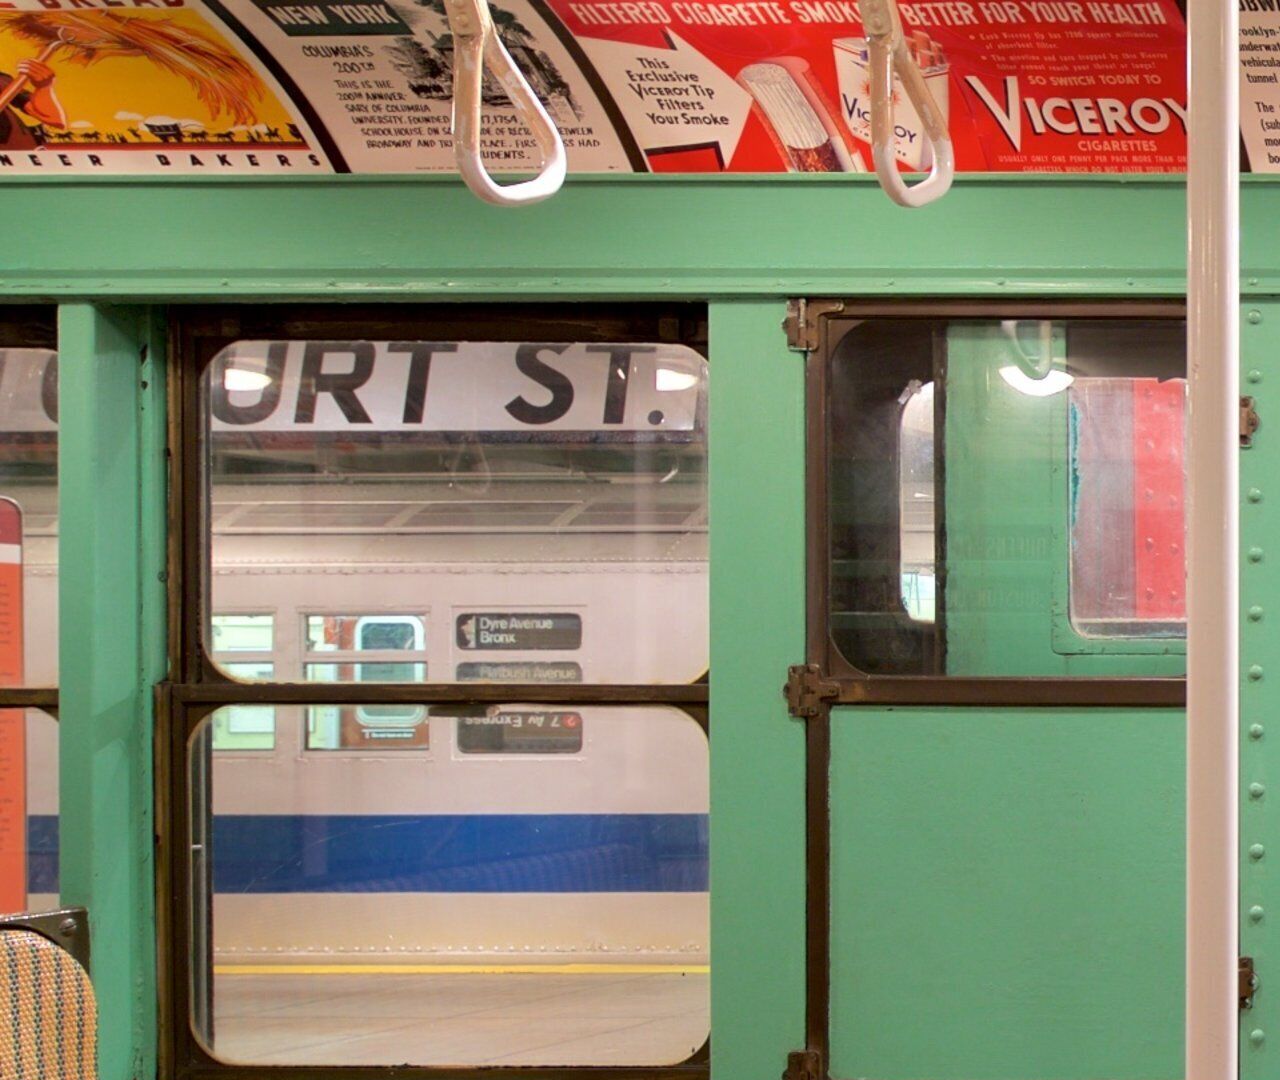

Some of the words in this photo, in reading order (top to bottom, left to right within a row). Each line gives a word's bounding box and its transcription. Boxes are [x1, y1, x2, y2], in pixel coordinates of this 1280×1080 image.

[266, 6, 330, 25] NEW
[328, 4, 399, 24] YORK
[569, 3, 672, 25] FILTERED
[671, 1, 792, 26] CIGARETTE
[794, 1, 864, 24] SMOK
[902, 3, 979, 25] BETTER
[980, 2, 1026, 24] FOR
[1025, 1, 1091, 23] YOUR
[1088, 1, 1168, 25] HEALTH
[302, 45, 375, 58] COLUMBIA'S
[636, 57, 670, 69] This
[625, 70, 700, 83] Exclusive
[1027, 75, 1047, 86] SO
[1050, 75, 1095, 87] SWITCH
[1099, 75, 1140, 86] TODAY
[1144, 74, 1163, 85] TO
[1246, 73, 1279, 84] tunnel
[334, 79, 361, 90] THIS
[628, 83, 691, 101] VICEROY
[690, 84, 715, 100] Tip
[385, 104, 432, 114] COLUMBIA
[657, 98, 705, 111] Filters
[1255, 101, 1275, 113] The
[645, 112, 680, 125] Your
[680, 113, 730, 126] Smoke
[964, 75, 1189, 153] VICEROY
[407, 116, 450, 126] FOUNDED
[1077, 140, 1158, 152] CIGARETTES
[156, 154, 321, 168] BAKERS
[505, 342, 664, 425] ST.
[480, 617, 508, 631] Dyre
[509, 617, 553, 629] Avenue
[480, 631, 516, 643] Bronx
[533, 667, 576, 680] Avenue
